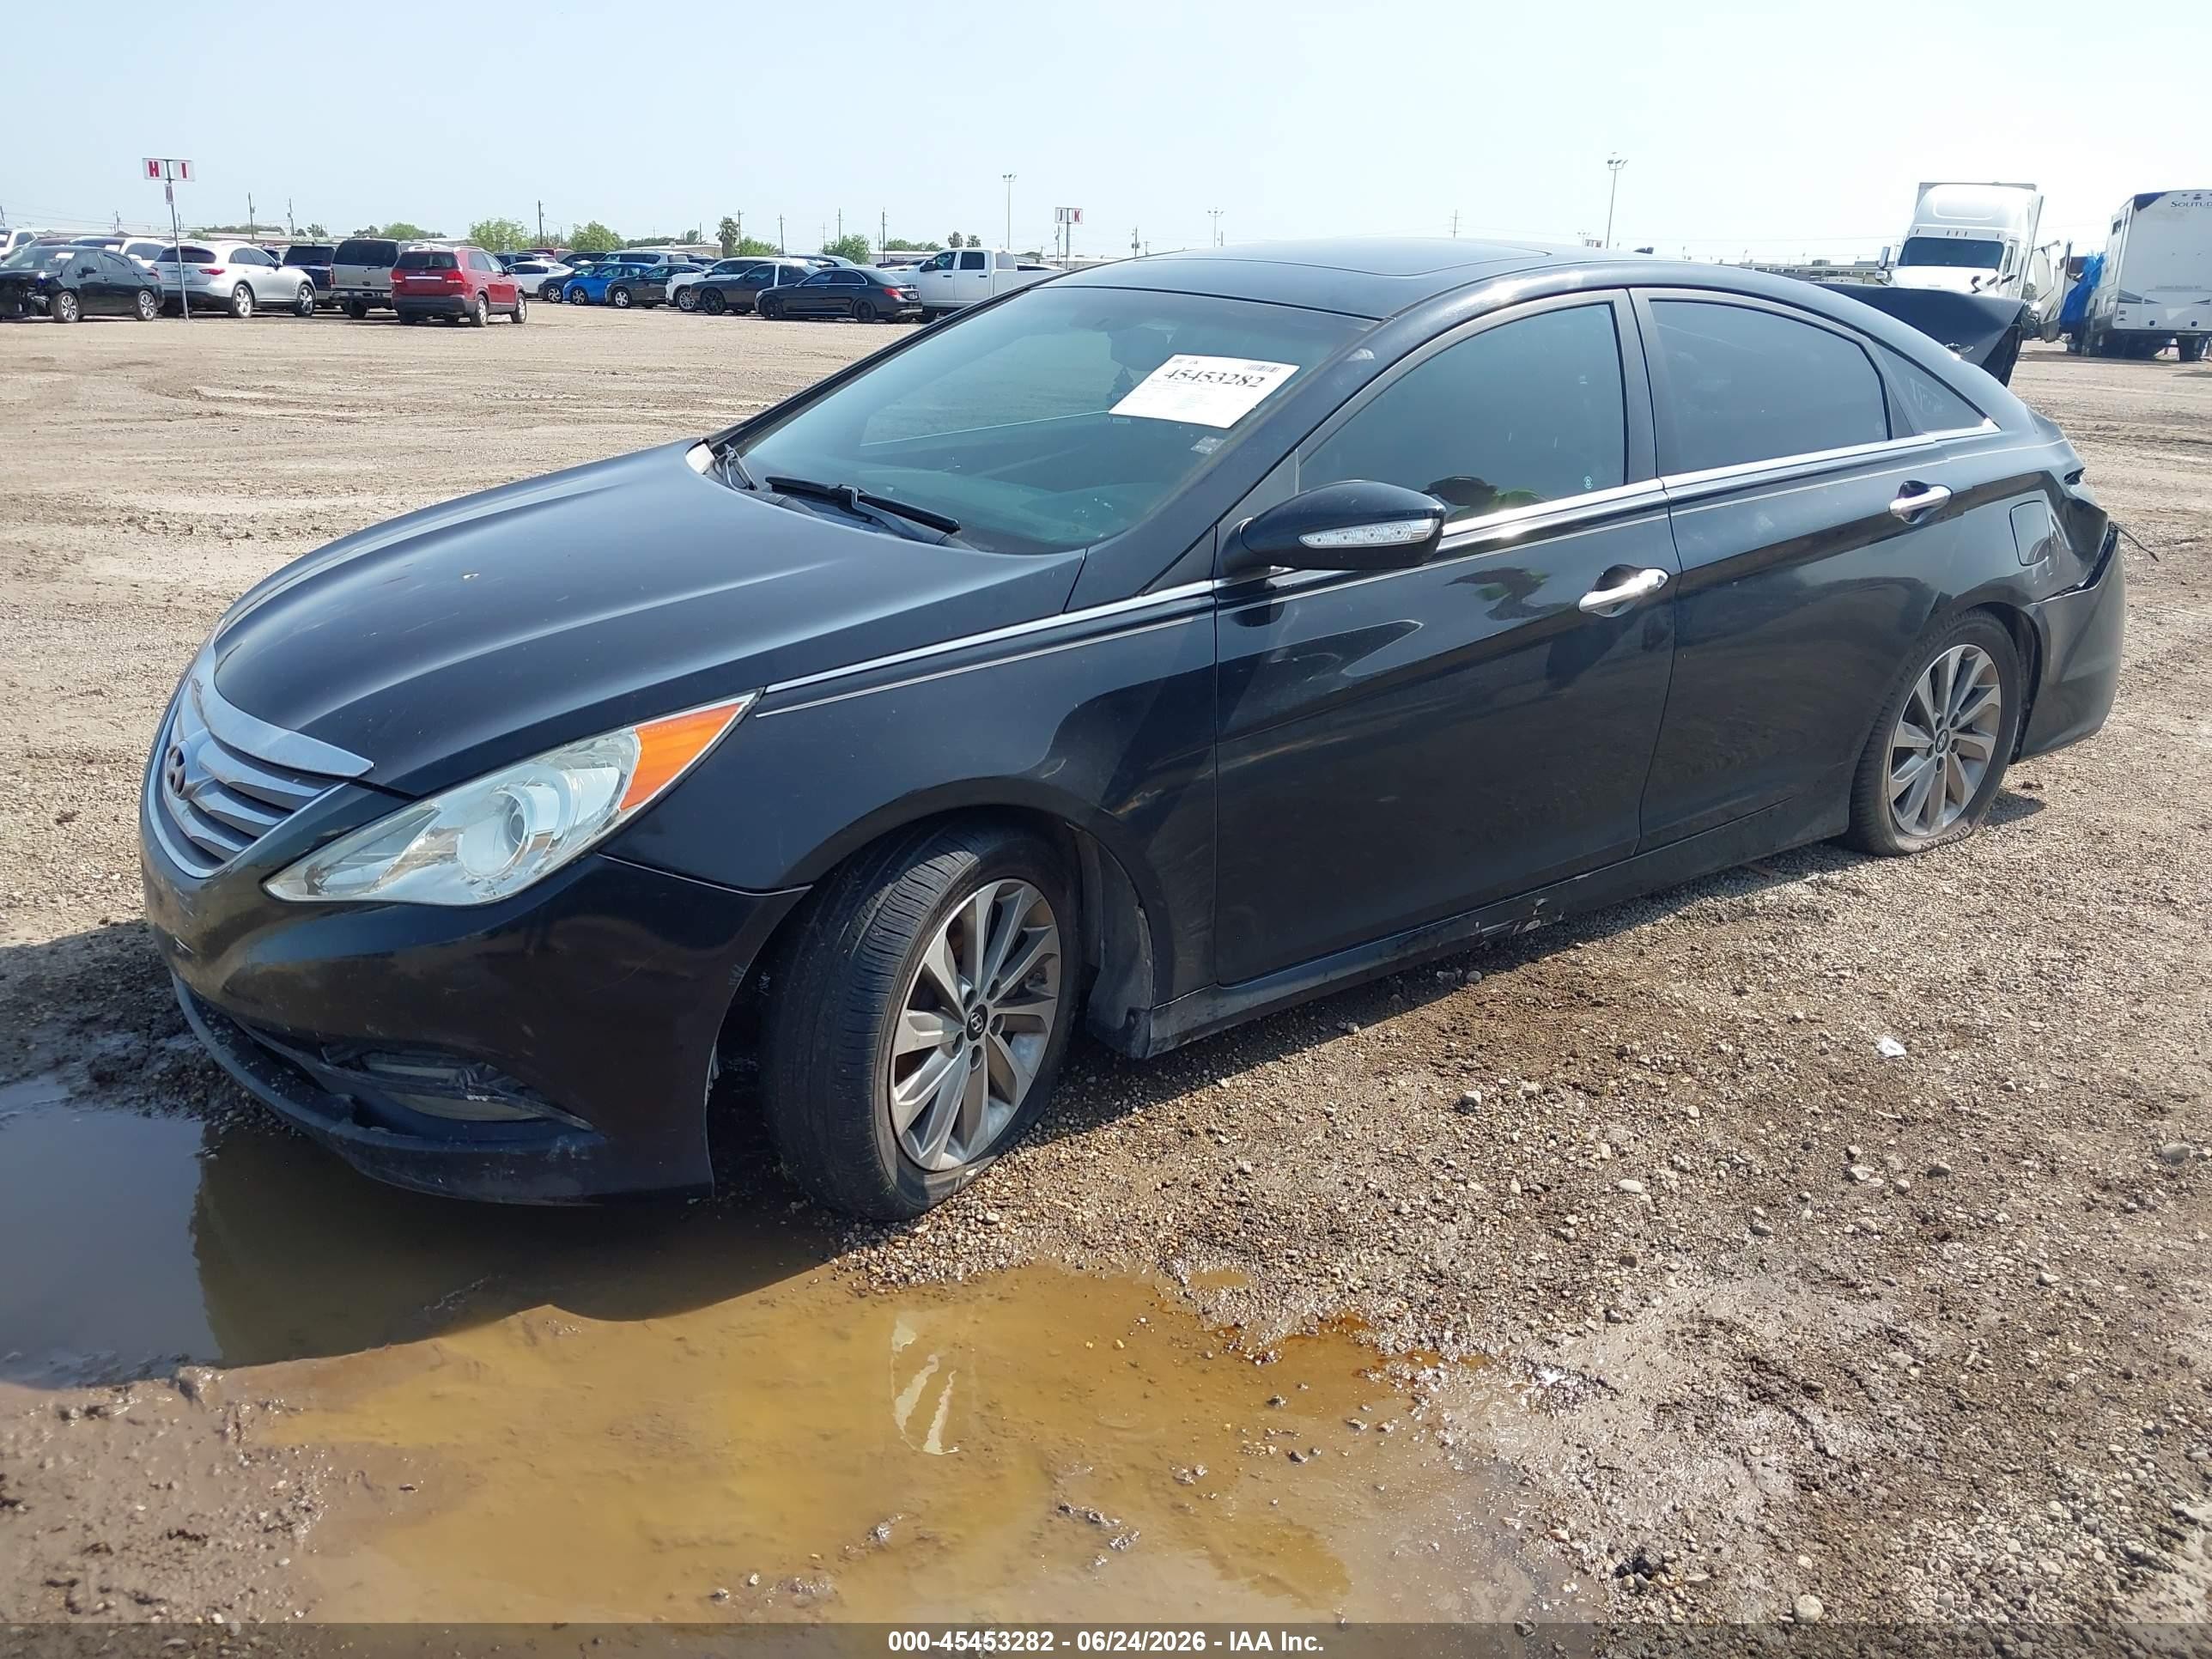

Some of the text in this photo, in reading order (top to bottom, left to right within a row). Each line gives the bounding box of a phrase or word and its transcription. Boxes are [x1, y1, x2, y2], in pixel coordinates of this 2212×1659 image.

[148, 161, 160, 178] H
[180, 162, 188, 179] I
[1059, 209, 1063, 222] J
[1074, 210, 1080, 222] K
[1164, 368, 1266, 388] 45453282
